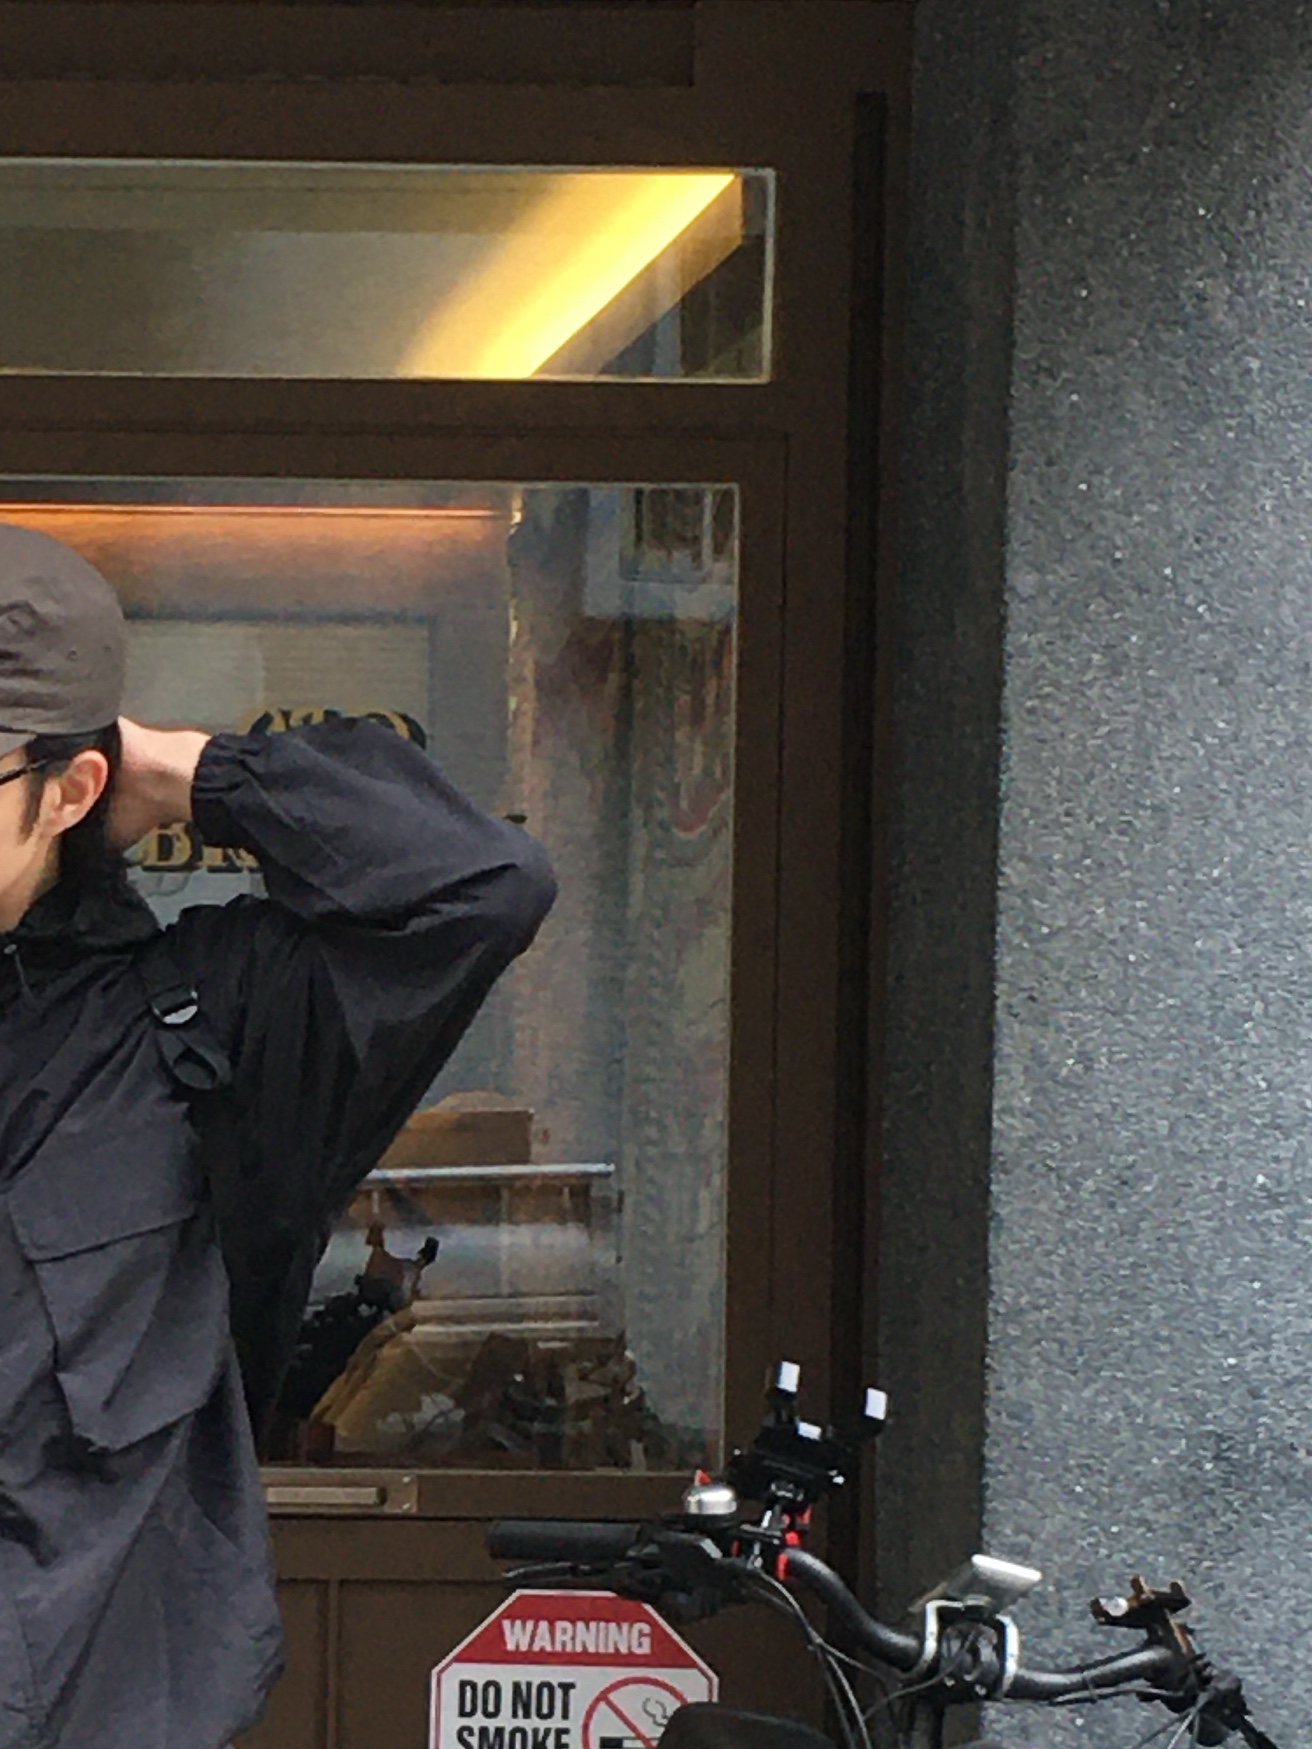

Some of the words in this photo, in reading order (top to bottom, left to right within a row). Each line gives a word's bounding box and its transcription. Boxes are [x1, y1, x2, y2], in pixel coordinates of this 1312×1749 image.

[501, 1619, 651, 1655] WARNING
[458, 1679, 502, 1719] DO
[511, 1681, 576, 1721] NOT
